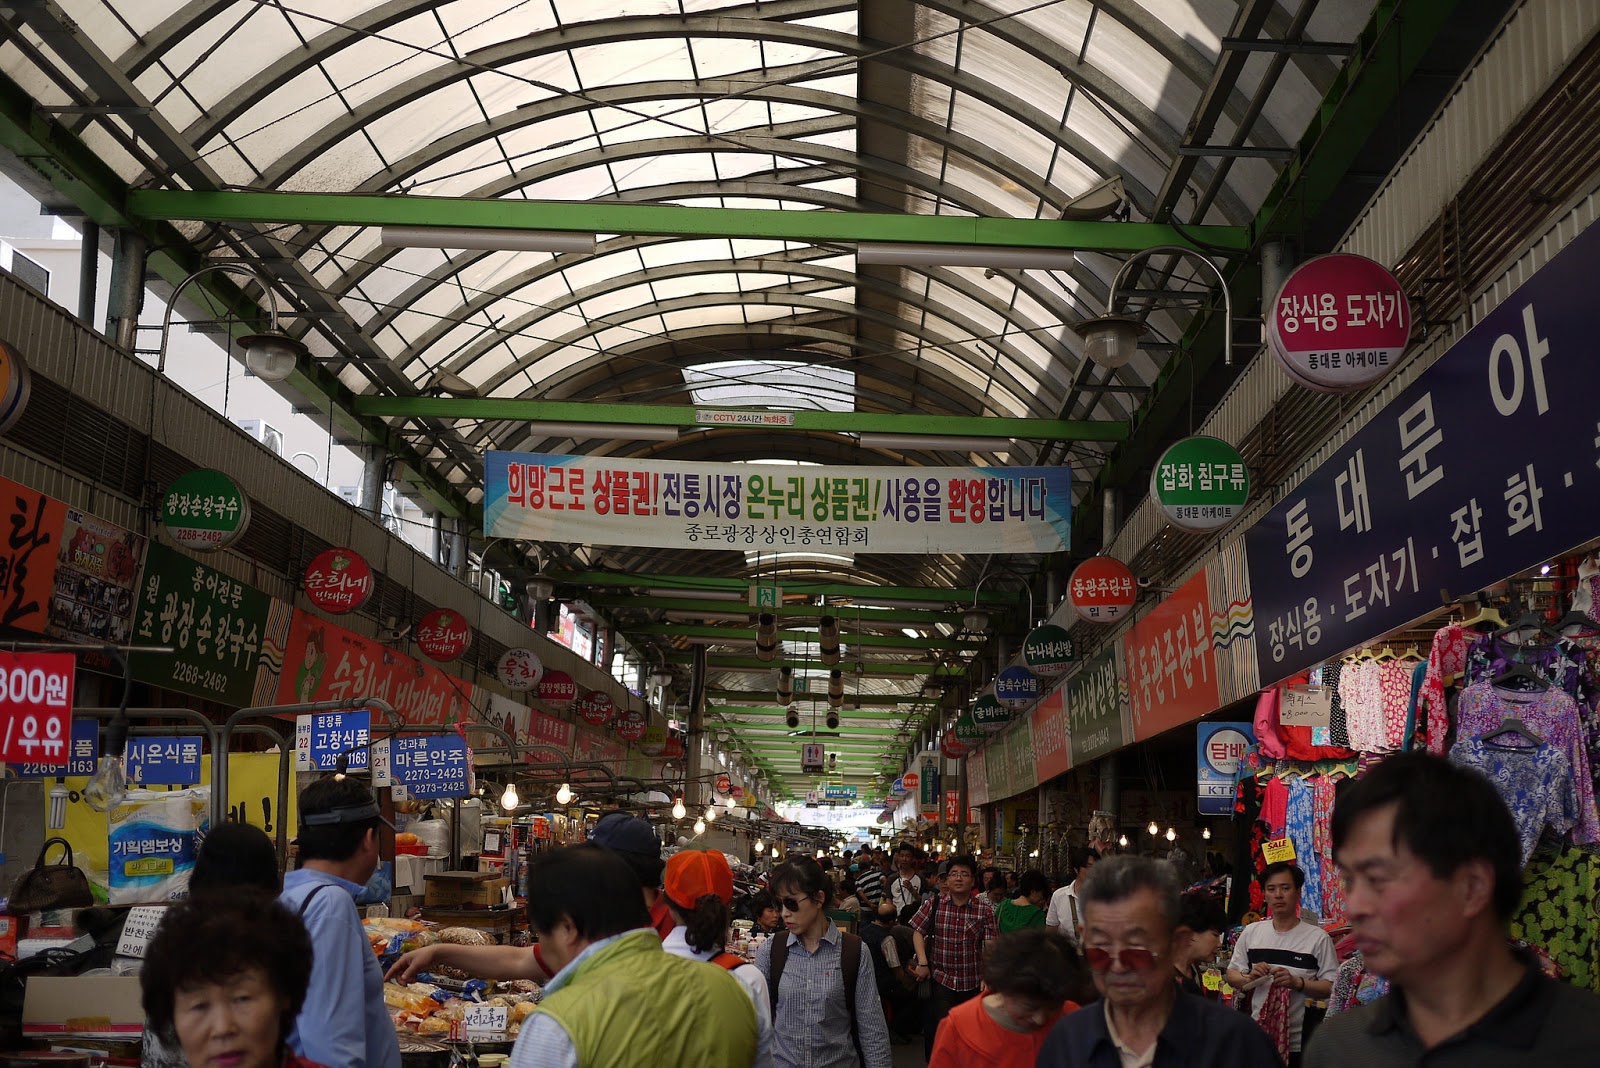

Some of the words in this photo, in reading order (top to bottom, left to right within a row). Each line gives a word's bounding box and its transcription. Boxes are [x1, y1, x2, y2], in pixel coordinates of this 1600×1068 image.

[1280, 292, 1339, 334] 장식용
[1346, 290, 1404, 330] 도자기
[1308, 352, 1341, 370] 동대문
[1345, 350, 1390, 369] 아케이트
[713, 413, 736, 422] CCTV
[737, 414, 762, 424] 24시간
[1160, 463, 1195, 492] 잡화
[1198, 462, 1246, 492] 침구류
[507, 462, 586, 511] 희망근로
[662, 471, 742, 520] 전통시장
[746, 473, 805, 521] 온누리
[882, 477, 942, 523] 사용을
[947, 477, 1048, 524] 환영합니다
[166, 492, 239, 521] 광장손칼국수
[1175, 506, 1199, 520] 동대문
[1201, 505, 1232, 519] 아케이트
[176, 528, 223, 542] 2268-2462
[191, 565, 243, 609] 홍어전문
[305, 569, 368, 593] 순희네
[315, 590, 353, 604] 빈대떡
[159, 591, 258, 672] 광장손칼국수
[418, 626, 468, 646] 순희네
[425, 642, 456, 654] 빈대떡
[1026, 639, 1073, 660] 누나네신발
[172, 661, 229, 694] 2268-2462
[997, 678, 1038, 692] 농축수산물
[1070, 658, 1116, 732] 누나네신발
[317, 715, 343, 729] 된장류
[299, 737, 309, 749] 22
[315, 728, 369, 750] 고창식품
[398, 738, 428, 751] 건과류
[129, 743, 198, 765] 시온식품
[321, 751, 367, 767] 2261163
[374, 757, 387, 767] 21
[395, 749, 465, 768] 마른안주
[405, 767, 464, 781] 2273-2425
[414, 781, 465, 794] 2273-2425
[113, 838, 184, 855] 기획엠보싱
[1267, 839, 1287, 850] SALE
